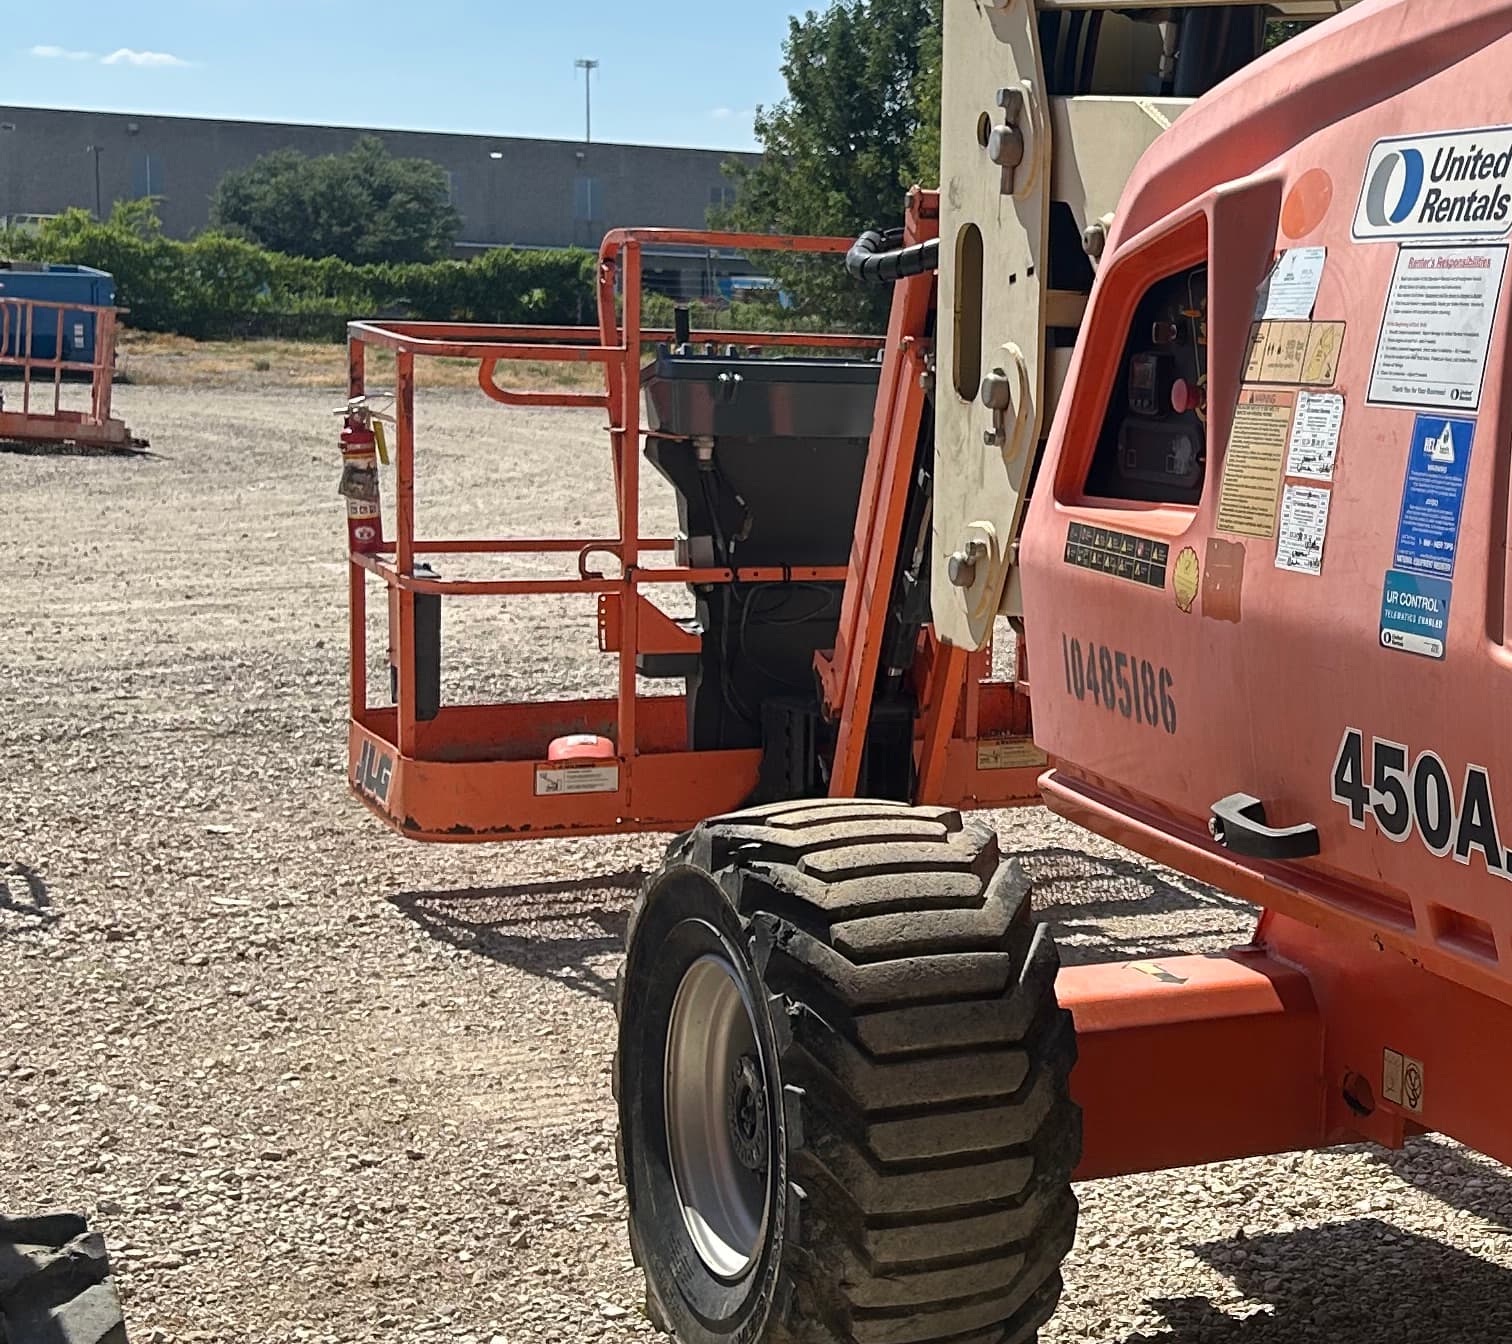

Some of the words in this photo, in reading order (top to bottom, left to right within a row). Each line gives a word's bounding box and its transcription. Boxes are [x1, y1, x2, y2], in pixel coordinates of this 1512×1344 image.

[1418, 184, 1511, 223] Rentals
[1386, 590, 1399, 604] UR
[1399, 593, 1439, 612] CONTROL
[1062, 632, 1177, 735] 10485186
[354, 738, 394, 804] JLG
